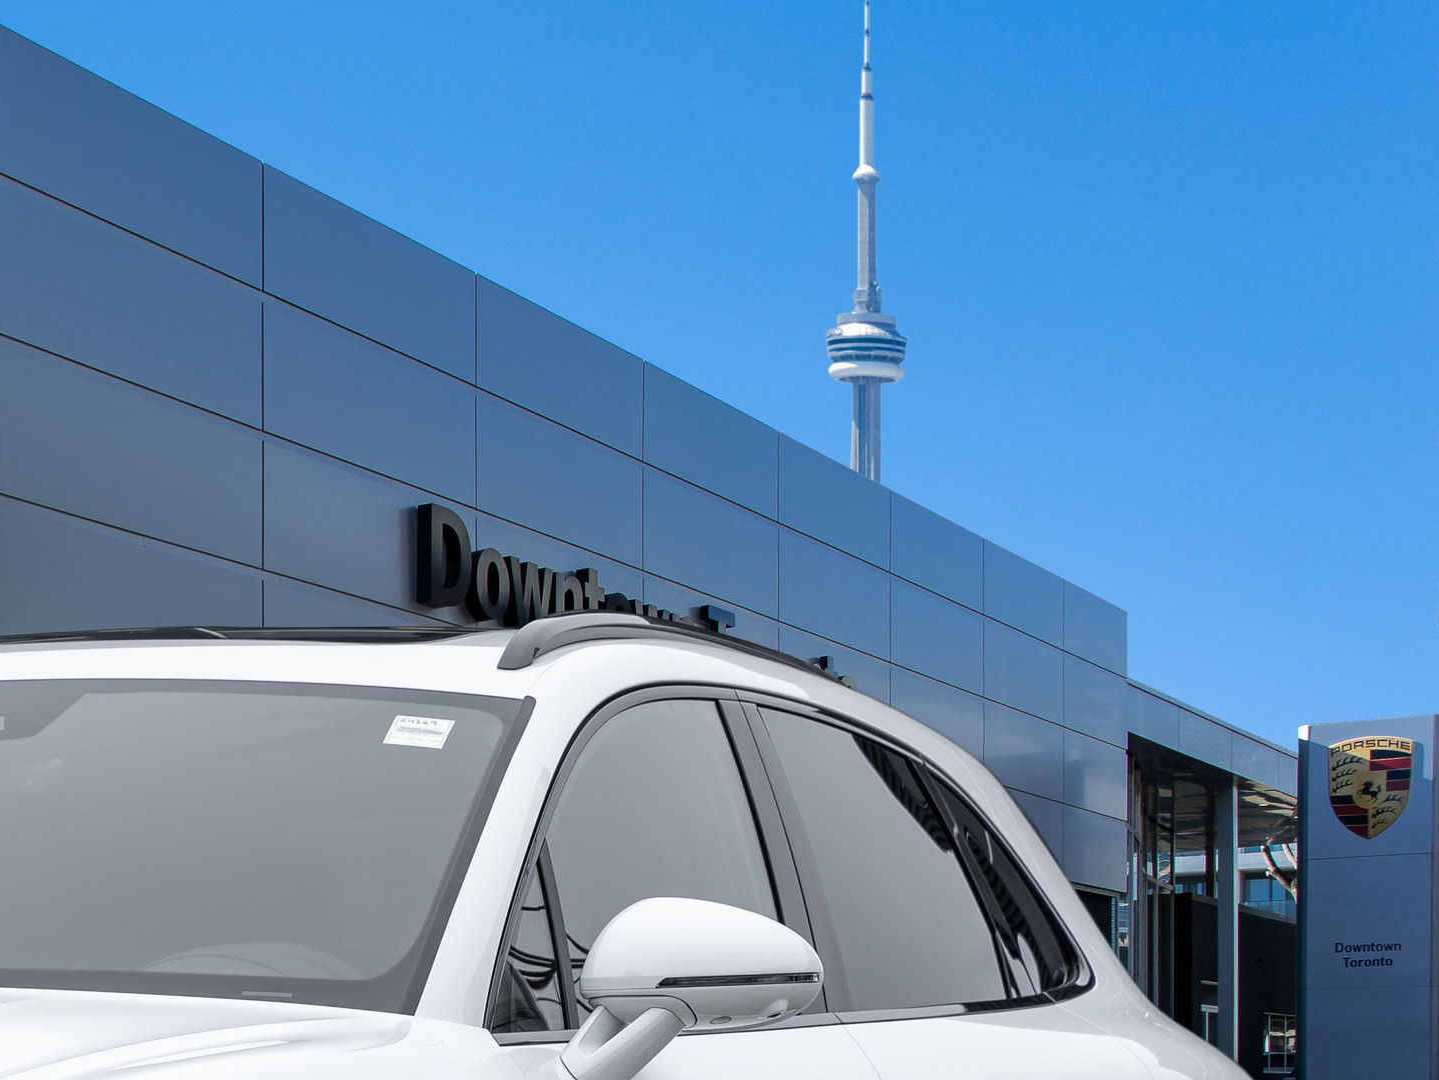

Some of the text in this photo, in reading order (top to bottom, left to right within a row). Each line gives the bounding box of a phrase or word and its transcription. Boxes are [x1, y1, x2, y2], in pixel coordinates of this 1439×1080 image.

[417, 503, 693, 626] Downt
[1330, 739, 1411, 756] PORSCHE
[1335, 942, 1402, 953] Downtown
[1342, 957, 1393, 968] Toronto
